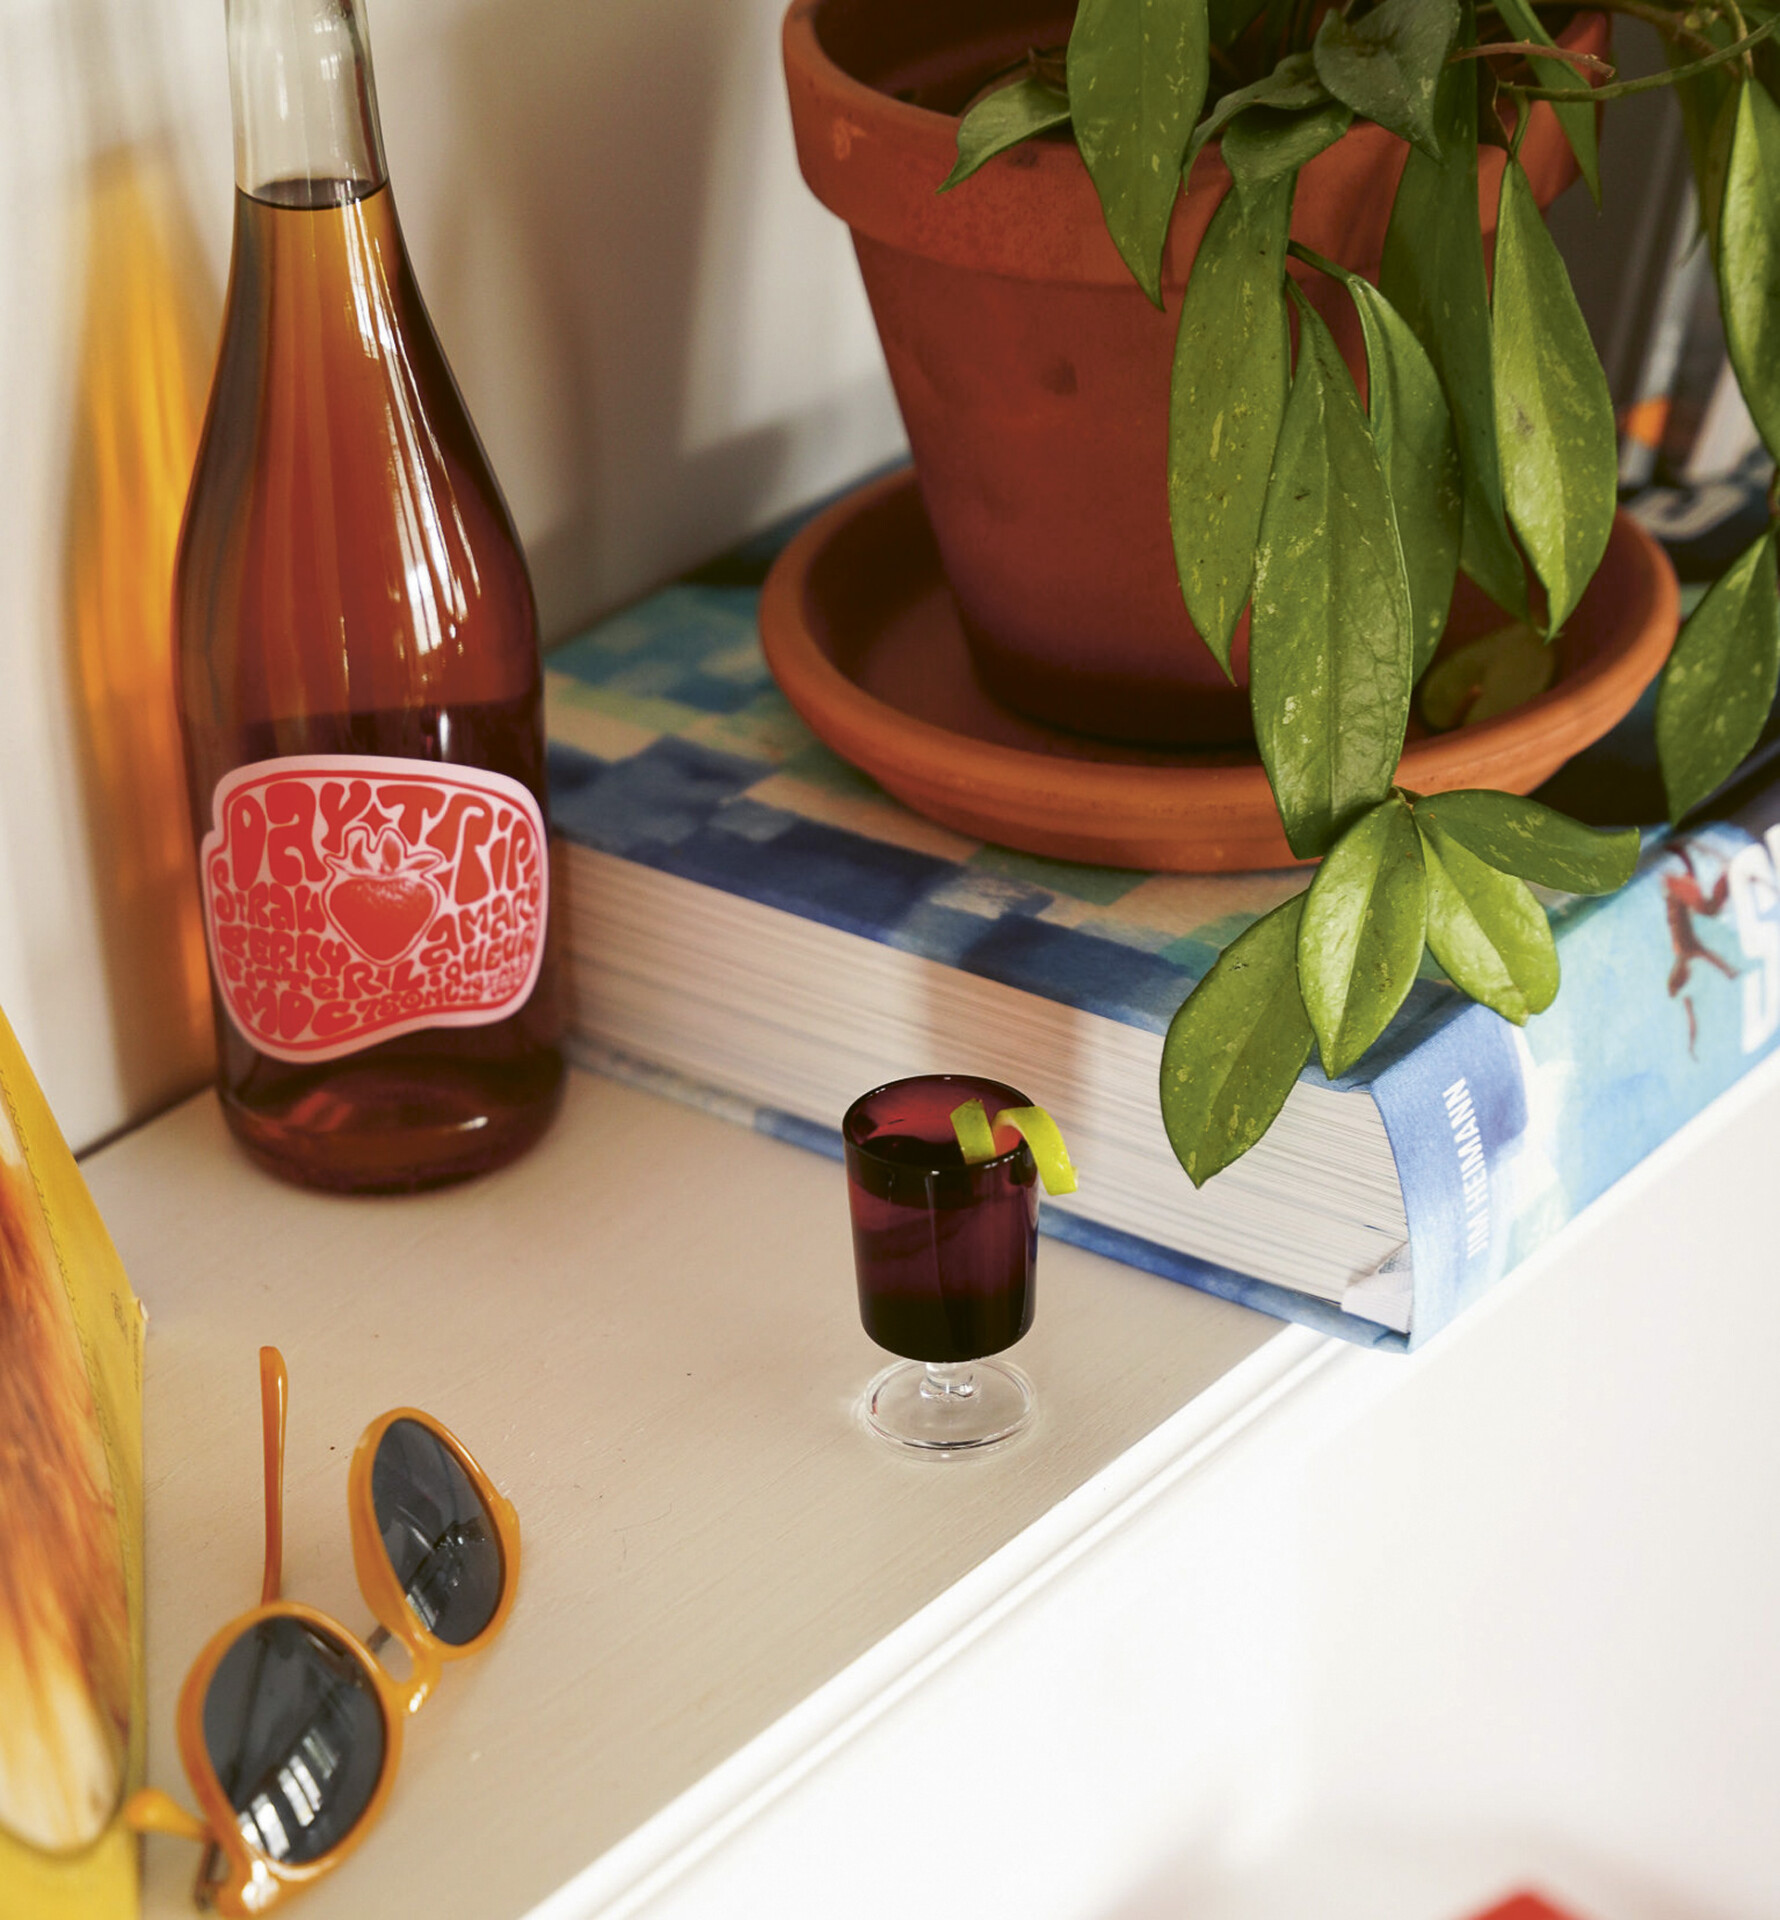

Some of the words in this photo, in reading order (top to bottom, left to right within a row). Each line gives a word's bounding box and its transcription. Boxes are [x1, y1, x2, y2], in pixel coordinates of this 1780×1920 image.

[230, 780, 372, 891] DAY
[212, 858, 328, 934] STRAW
[219, 924, 352, 978] BERRY
[232, 985, 359, 1040] MDC
[1442, 1076, 1488, 1214] HEIMANN
[1466, 1206, 1490, 1261] JIM
